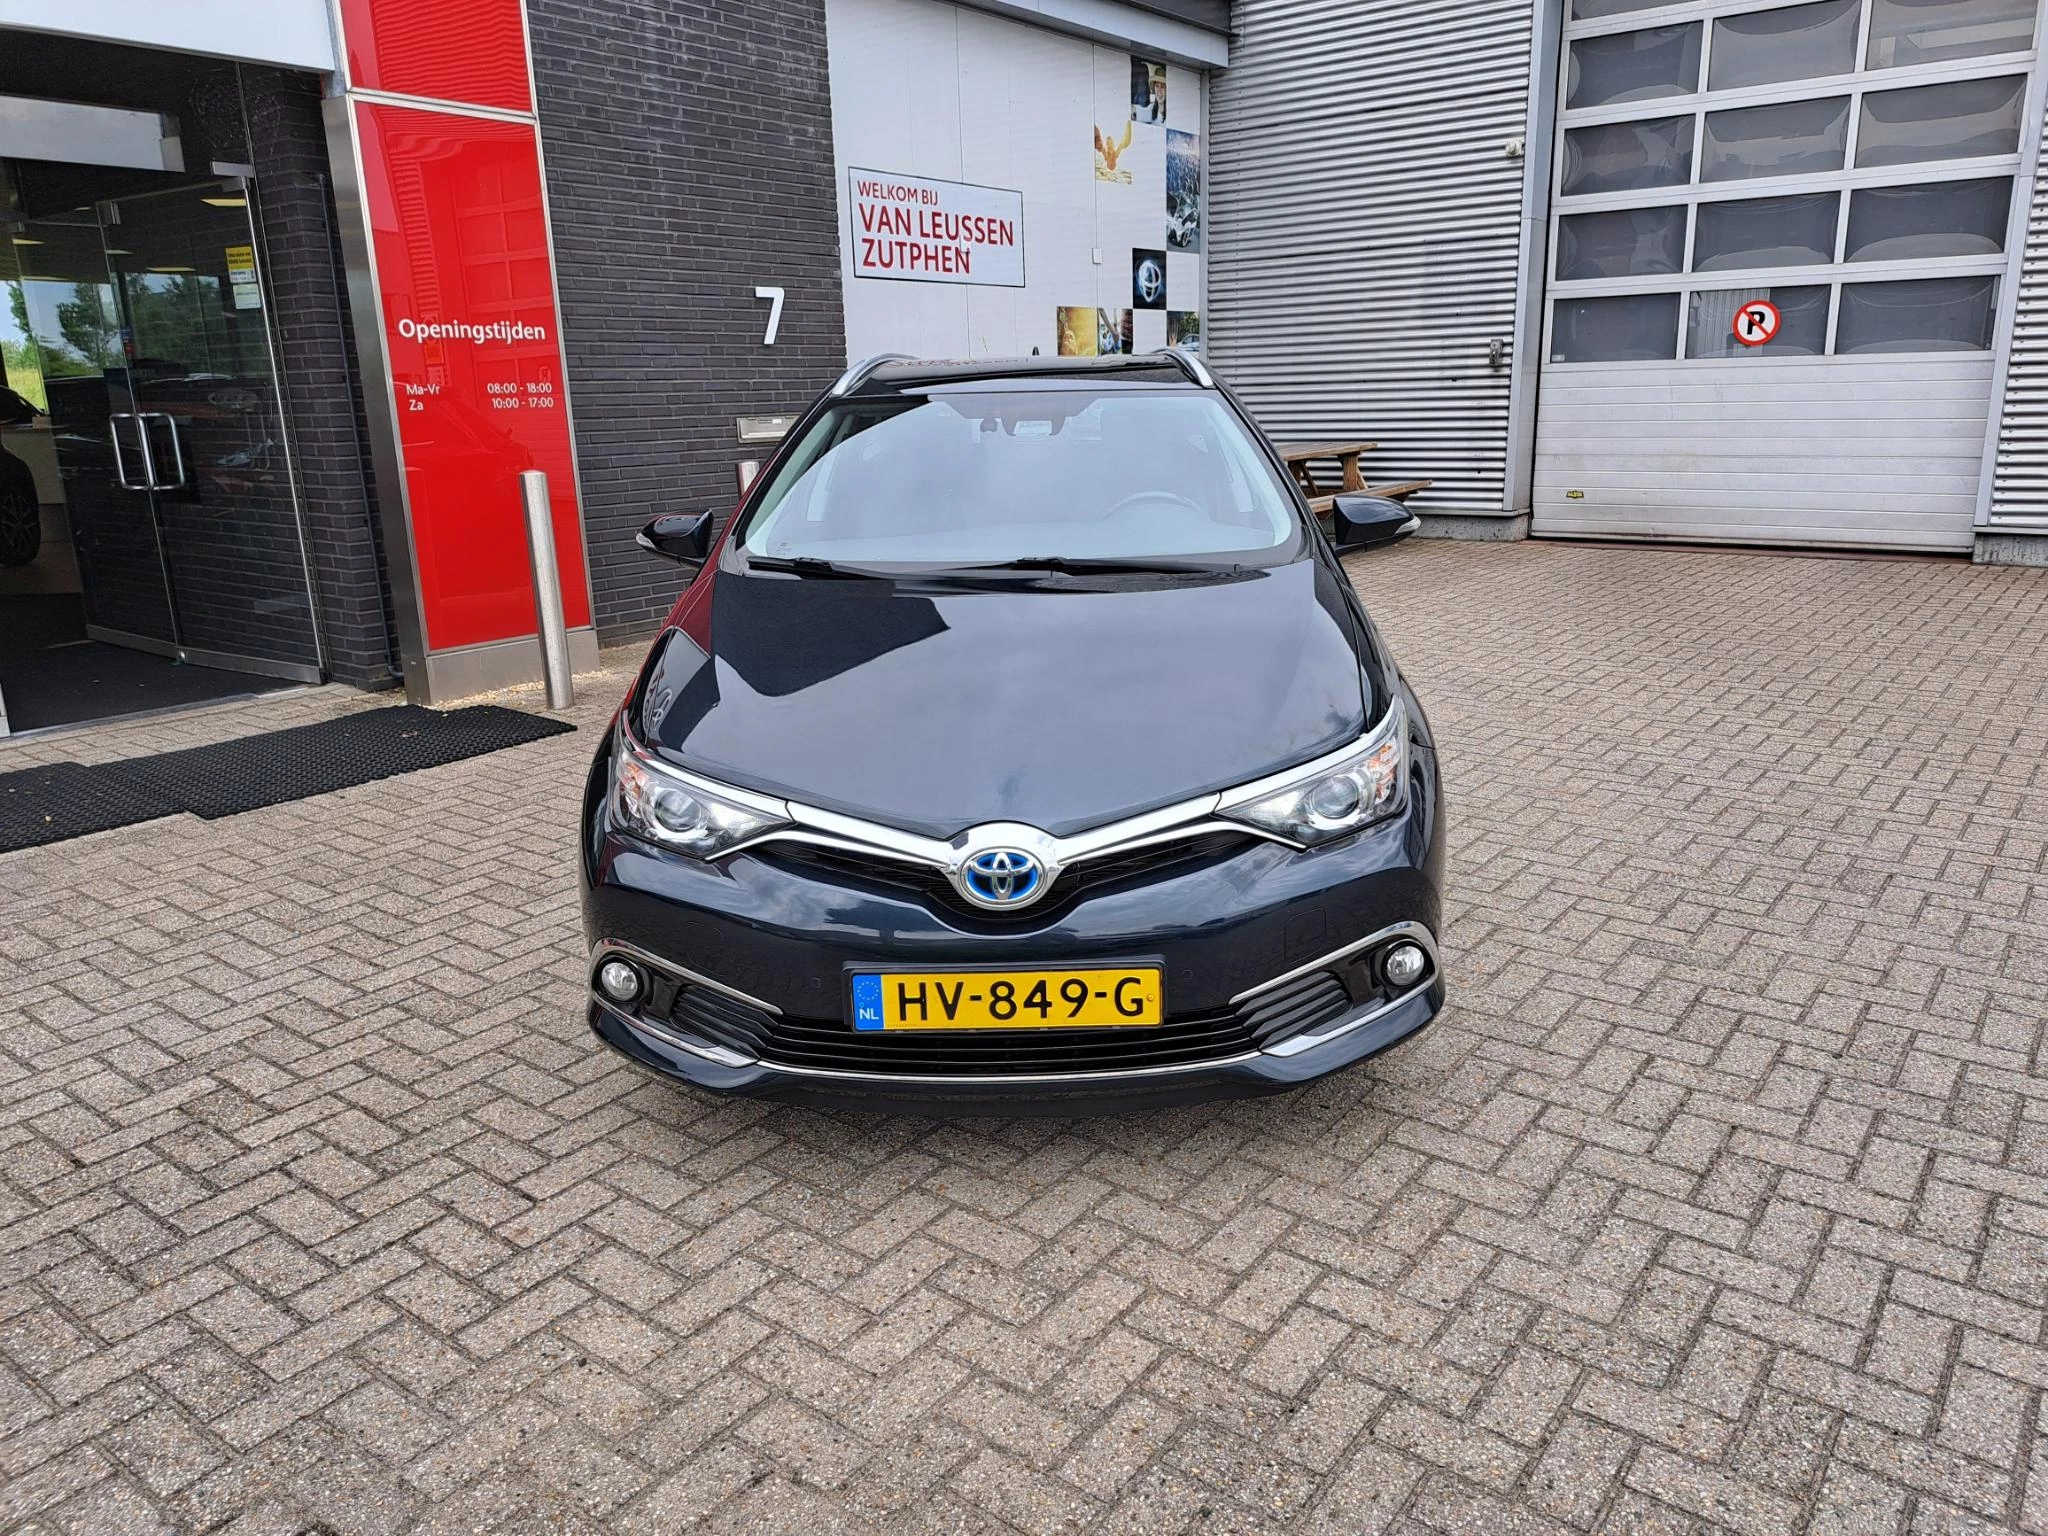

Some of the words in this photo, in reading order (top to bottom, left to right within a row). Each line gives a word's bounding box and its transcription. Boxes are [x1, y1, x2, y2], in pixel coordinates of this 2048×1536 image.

[857, 180, 918, 203] WELKOM
[922, 189, 938, 206] BIJ
[858, 203, 912, 236] VAN
[919, 210, 1014, 246] LEUSSEN
[862, 238, 970, 274] ZUTPHEN
[755, 286, 785, 345] 7
[399, 319, 546, 344] Openingstijden
[406, 383, 440, 395] Ma-Vr
[487, 383, 517, 394] 08:00
[527, 383, 552, 393] 18:00
[409, 400, 424, 411] Za
[492, 397, 519, 408] 10:00
[528, 397, 554, 408] 17:00
[898, 977, 1144, 1021] HV-849-G
[859, 1008, 880, 1020] NL
